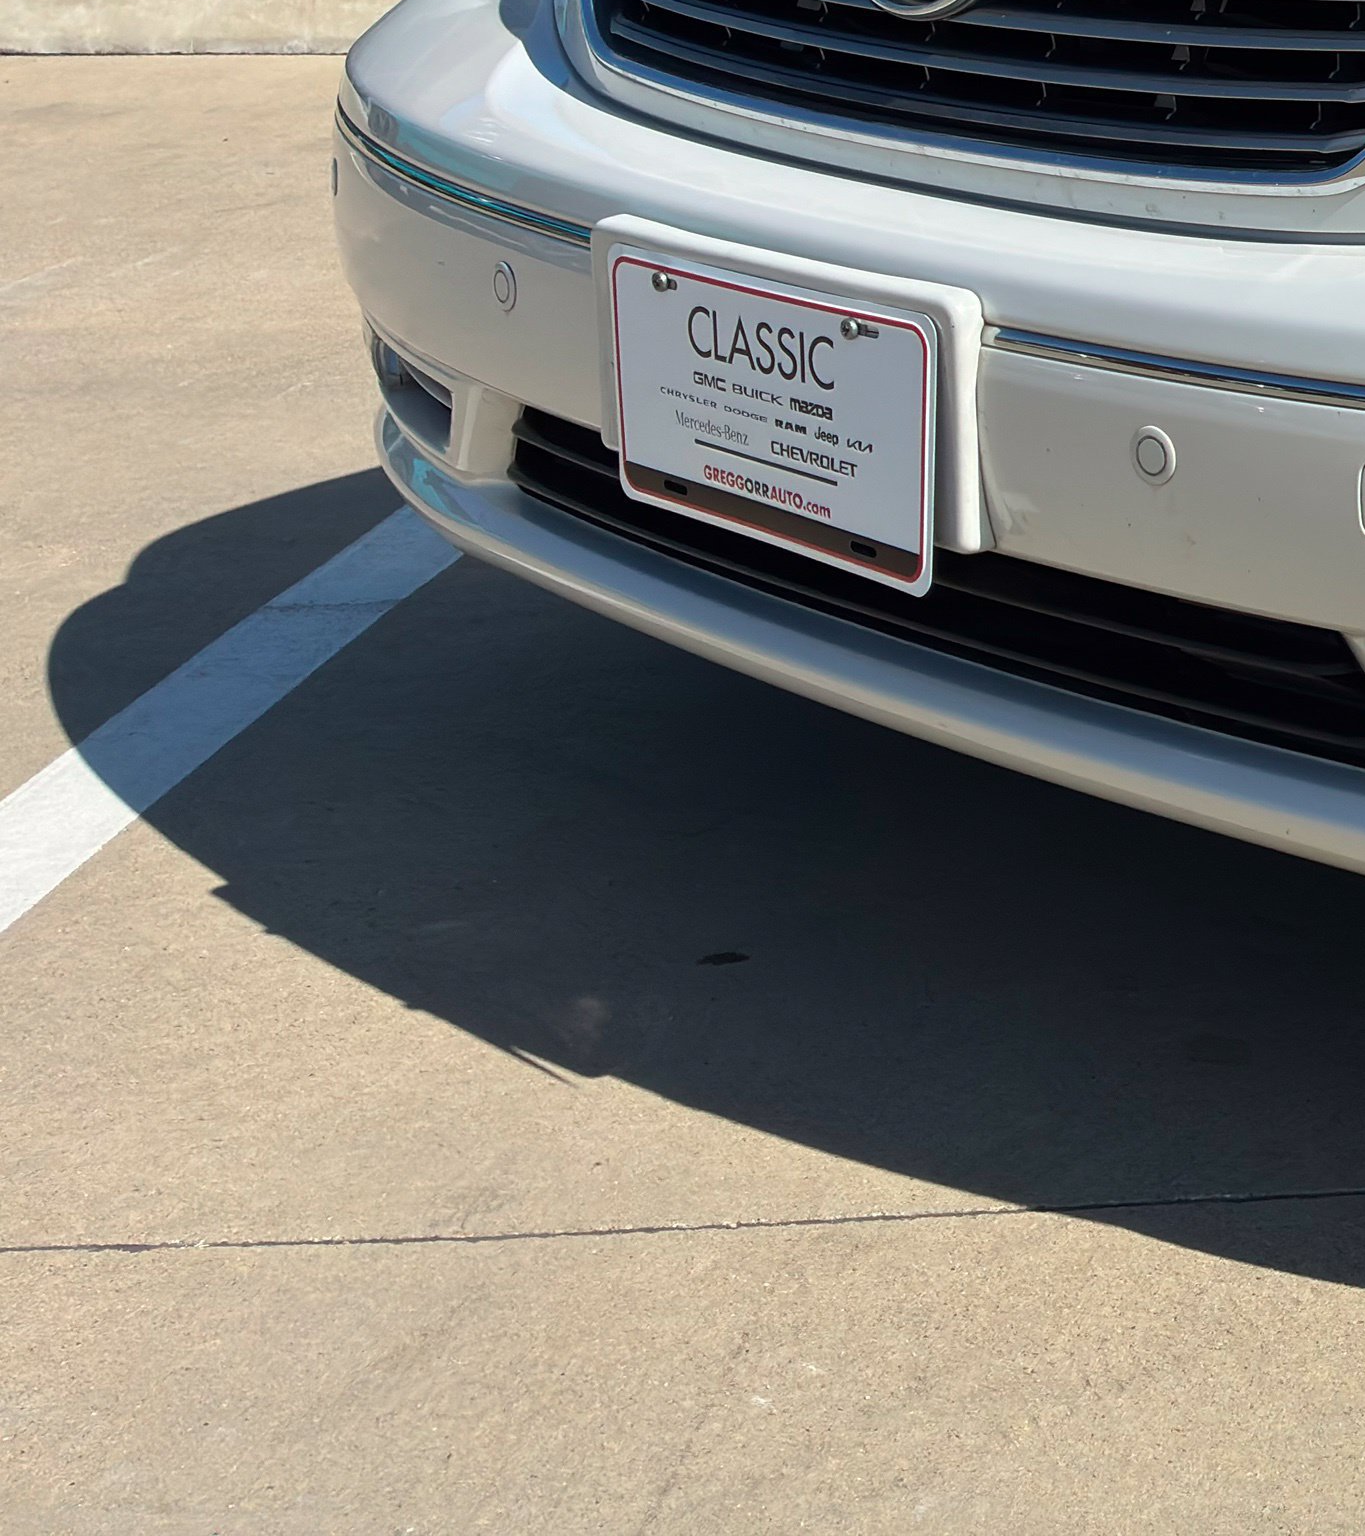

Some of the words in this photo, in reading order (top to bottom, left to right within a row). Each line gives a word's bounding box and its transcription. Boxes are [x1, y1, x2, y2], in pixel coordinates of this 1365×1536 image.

[688, 306, 835, 390] CLASSIC
[660, 386, 718, 409] CHRYSLER
[723, 405, 768, 423] DODGE
[774, 418, 808, 435] RAM
[814, 426, 840, 447] Jeep
[693, 370, 727, 392] GMC
[732, 383, 784, 406] BUICK
[675, 409, 750, 446] Mercedes-Benz
[770, 440, 858, 478] CHEVROLET
[703, 464, 831, 519] GREGGORRAUTO.com
